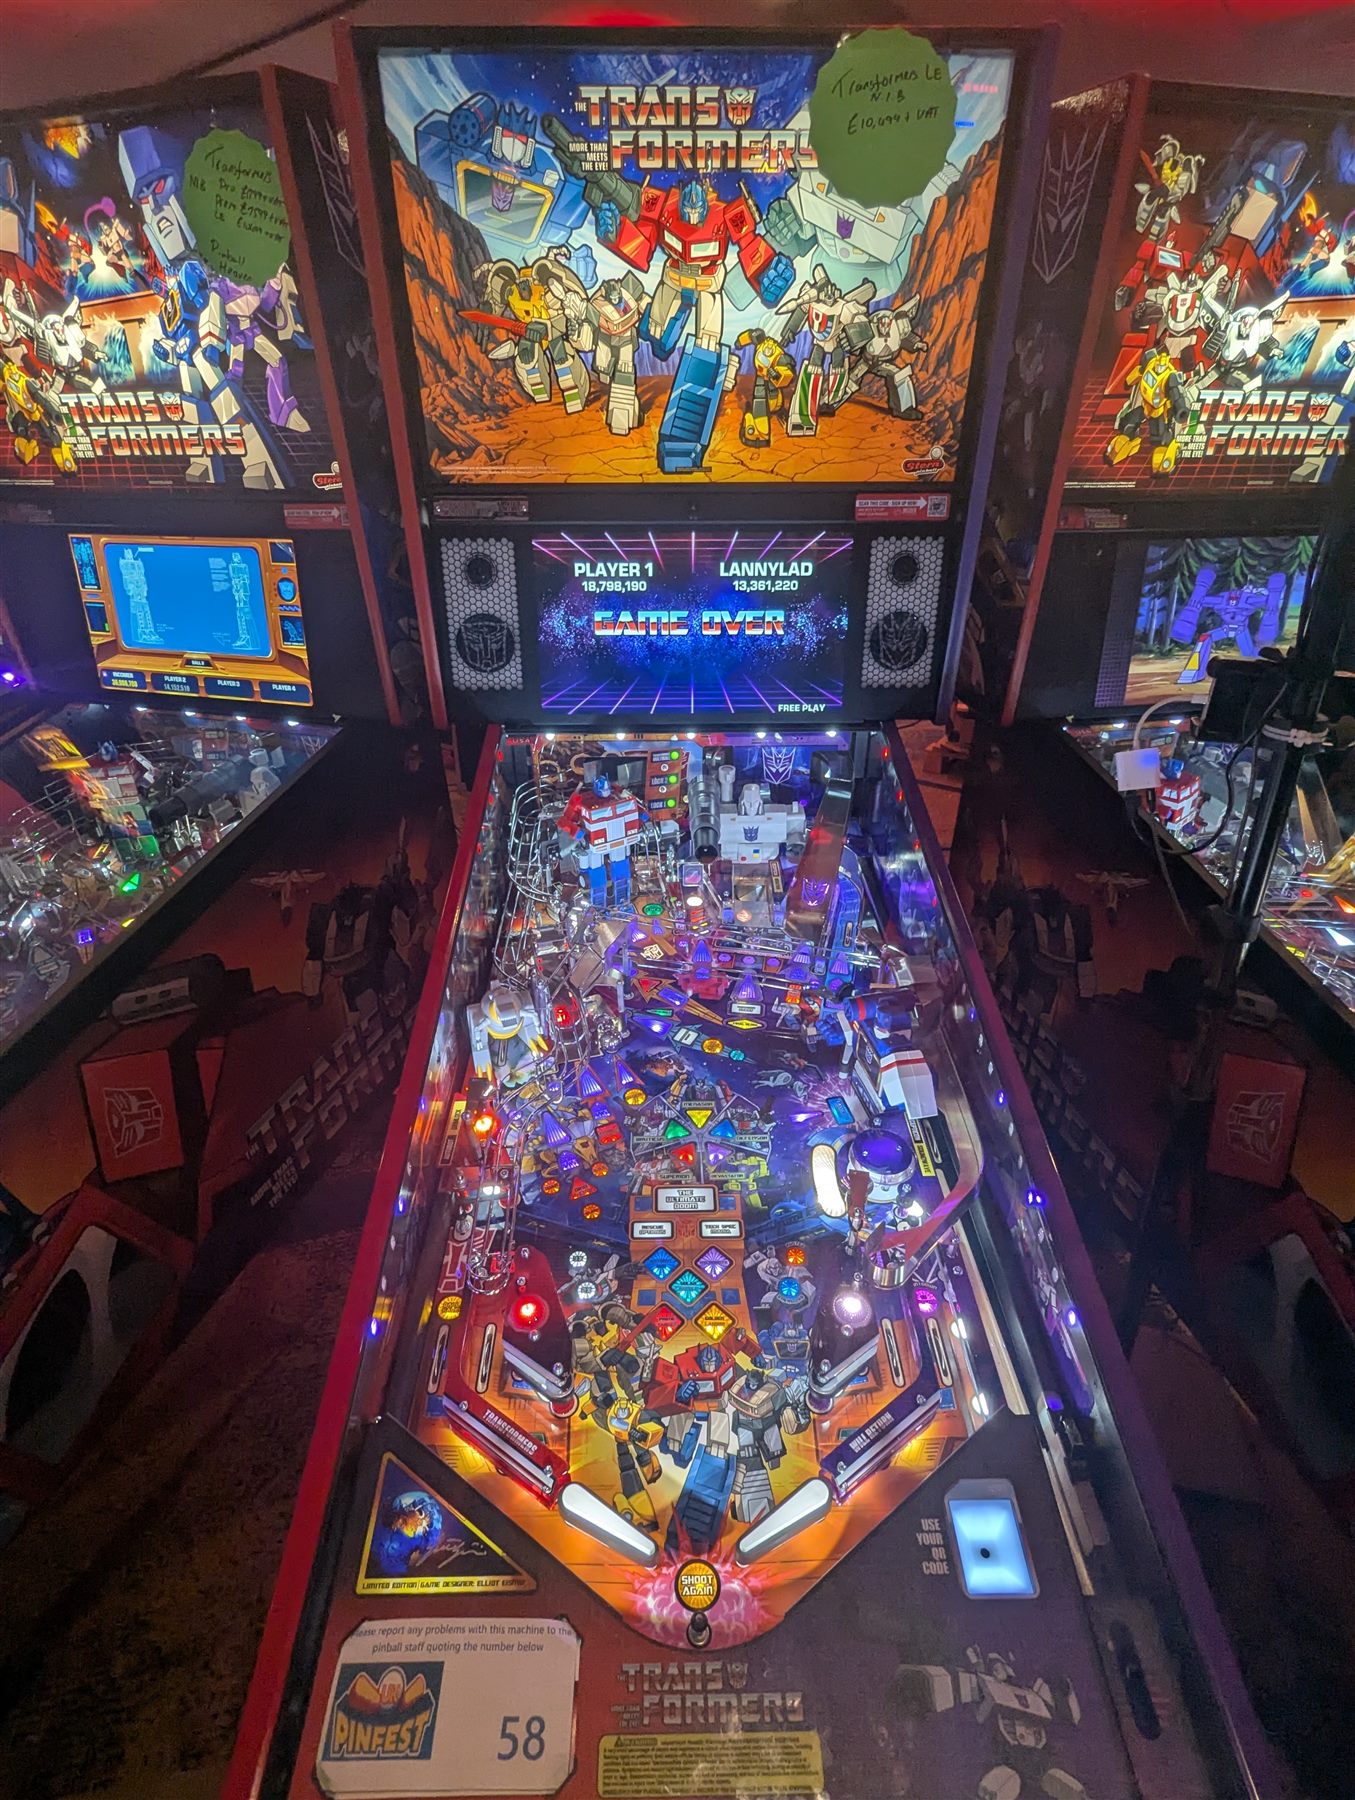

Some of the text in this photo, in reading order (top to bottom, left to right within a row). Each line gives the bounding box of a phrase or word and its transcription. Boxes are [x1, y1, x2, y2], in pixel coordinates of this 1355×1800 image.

[925, 63, 943, 80] LE
[574, 86, 720, 126] THE TRANS
[917, 106, 940, 119] VAT
[569, 142, 608, 152] MORE THAN
[610, 130, 819, 169] FORMERS
[586, 151, 609, 162] MEETS
[581, 161, 609, 171] THE EYE!
[59, 391, 160, 423] TRANS
[1200, 390, 1310, 422] TRANS
[89, 424, 247, 456] FORMERS
[1206, 425, 1350, 456] FORMER
[574, 562, 654, 577] PLAYER 1
[720, 562, 813, 577] LANNYLAD
[581, 580, 648, 593] 18,798,190
[732, 580, 799, 592] 13,361,220
[594, 610, 785, 636] GAME OVER
[777, 703, 826, 713] FREE PLAY
[482, 1409, 538, 1456] TRANSFORMERS
[849, 1412, 895, 1453] WILL RETURN
[921, 1518, 941, 1531] USE
[916, 1532, 944, 1546] YOUR
[931, 1547, 947, 1560] QR
[922, 1561, 950, 1575] CODE
[681, 1575, 713, 1585] SHOOT
[682, 1586, 713, 1596] AGAIN
[378, 1626, 405, 1639] report
[407, 1627, 423, 1638] any
[425, 1625, 466, 1636] problems
[468, 1624, 488, 1634] with
[490, 1624, 507, 1634] this
[508, 1624, 545, 1635] machine
[547, 1625, 556, 1635] to
[558, 1625, 572, 1636] the
[372, 1642, 544, 1654] pinball staff quoting the number below
[622, 1662, 723, 1692] TRANS
[642, 1692, 805, 1725] FORMERS
[332, 1709, 430, 1755] PINFEST
[497, 1715, 547, 1761] 58
